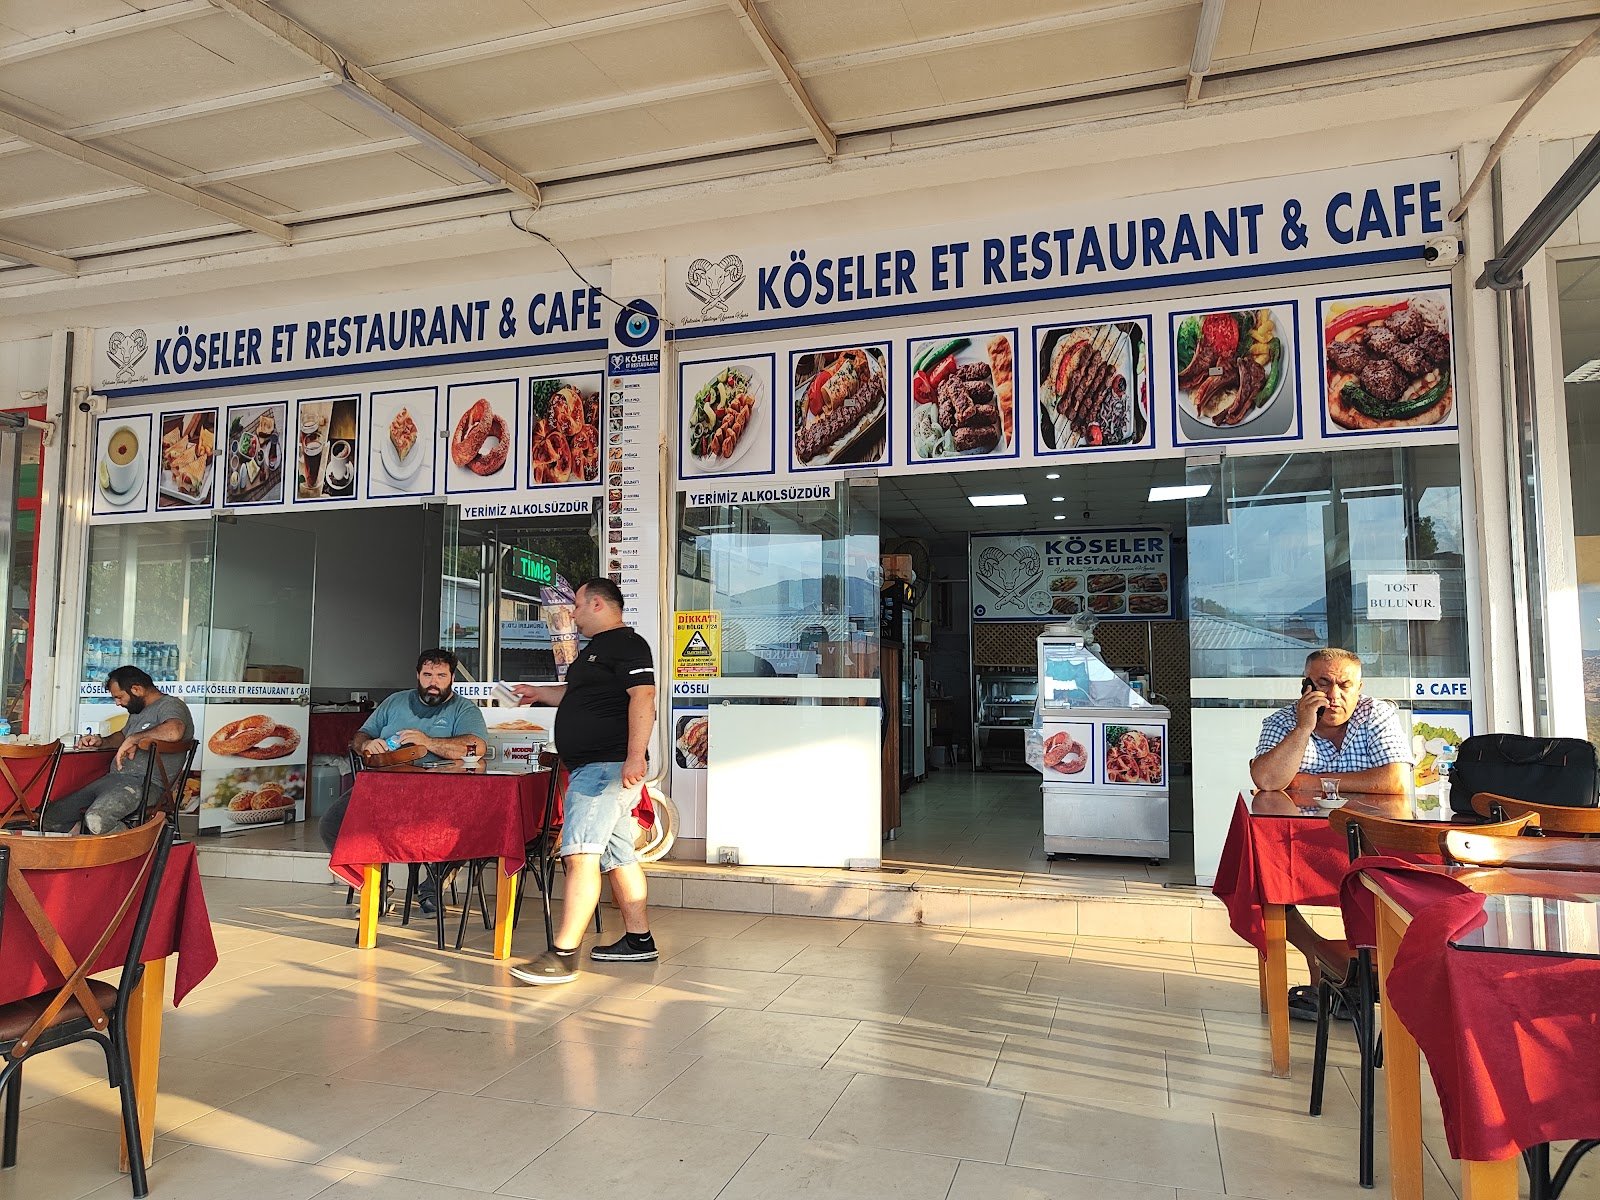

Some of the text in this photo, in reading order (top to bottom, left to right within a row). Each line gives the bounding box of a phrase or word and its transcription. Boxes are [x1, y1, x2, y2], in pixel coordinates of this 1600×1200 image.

[758, 180, 1445, 310] KÖSELER ET RESTAURANT & CAFE
[154, 287, 602, 376] KÖSELER ET RESTAURANT & CAFE
[625, 353, 659, 363] KÖSELER
[631, 361, 659, 369] RESTAURANT
[690, 485, 831, 505] YERİMİZ ALKOLSÜZDÜR
[464, 500, 589, 518] YERİMİZ ALKOLSÜZDÜR
[1045, 536, 1165, 555] KÖSELER
[1047, 553, 1164, 566] ET RESTAURANT
[1384, 583, 1418, 592] TOST
[1370, 598, 1436, 608] BULUNUR.
[678, 613, 717, 624] DİKKAT!
[80, 683, 109, 694] KÖSELE
[178, 685, 183, 693] &
[185, 684, 205, 694] CAFE
[205, 683, 237, 694] KÖSELER
[238, 686, 246, 694] ET
[247, 686, 290, 695] RESTAURANT
[296, 687, 309, 696] CAF
[453, 686, 493, 696] SELER ET
[674, 681, 709, 694] KÖSEL
[1415, 683, 1467, 695] & CAFE
